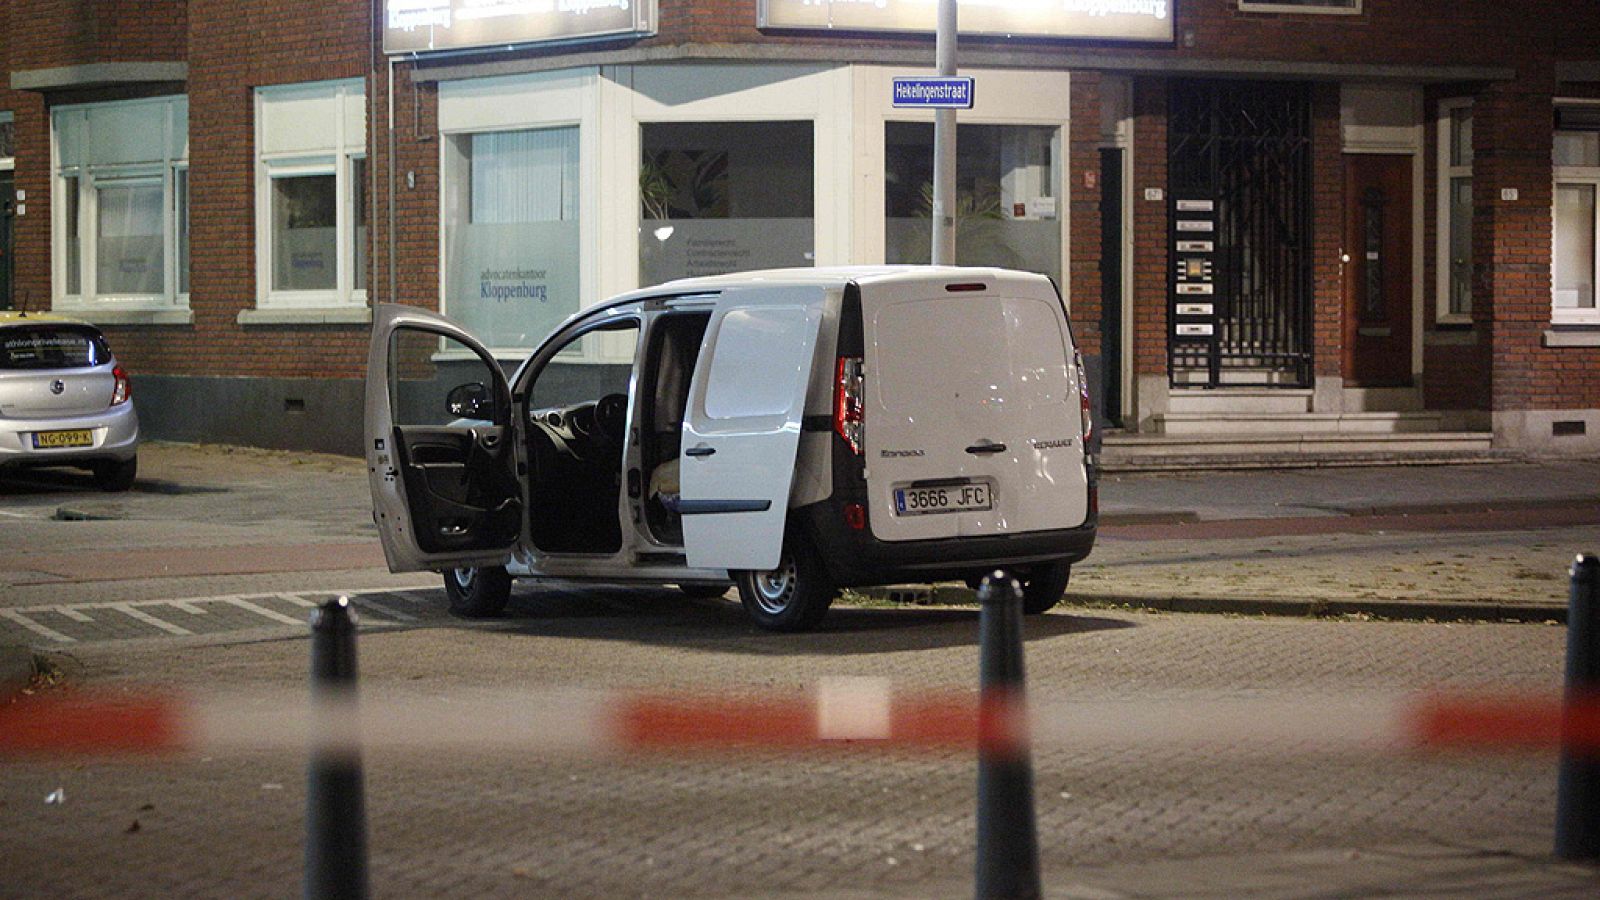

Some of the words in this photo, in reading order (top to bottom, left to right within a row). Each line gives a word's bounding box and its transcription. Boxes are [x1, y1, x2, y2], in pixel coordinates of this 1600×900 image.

[896, 82, 967, 103] Hekelingenstraat
[481, 281, 547, 303] Kloppenburg
[40, 432, 90, 445] NG-099-K
[909, 488, 949, 509] 3666
[957, 487, 985, 506] JFC
